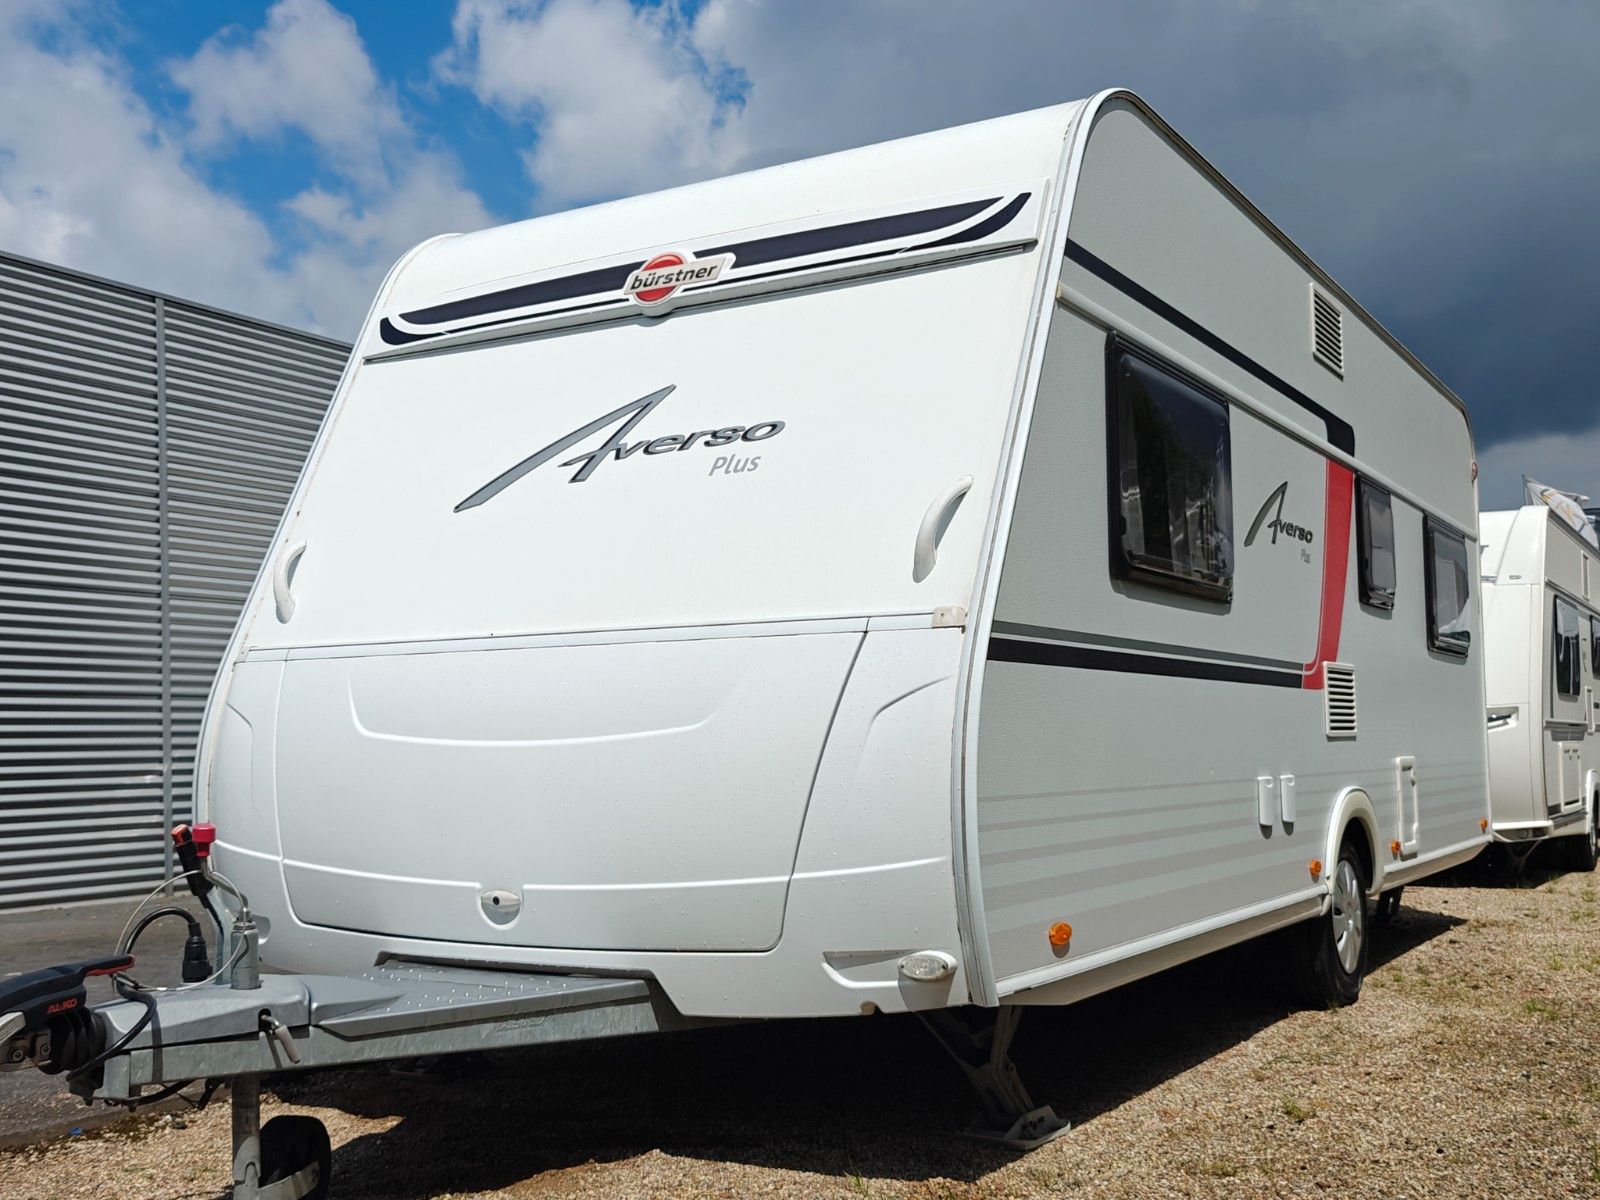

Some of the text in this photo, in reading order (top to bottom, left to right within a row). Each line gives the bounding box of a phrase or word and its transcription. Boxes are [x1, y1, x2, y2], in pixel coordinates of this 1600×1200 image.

[630, 265, 718, 290] bürstner
[453, 384, 785, 513] Averso
[708, 453, 761, 477] Plus
[1244, 481, 1313, 547] Averso
